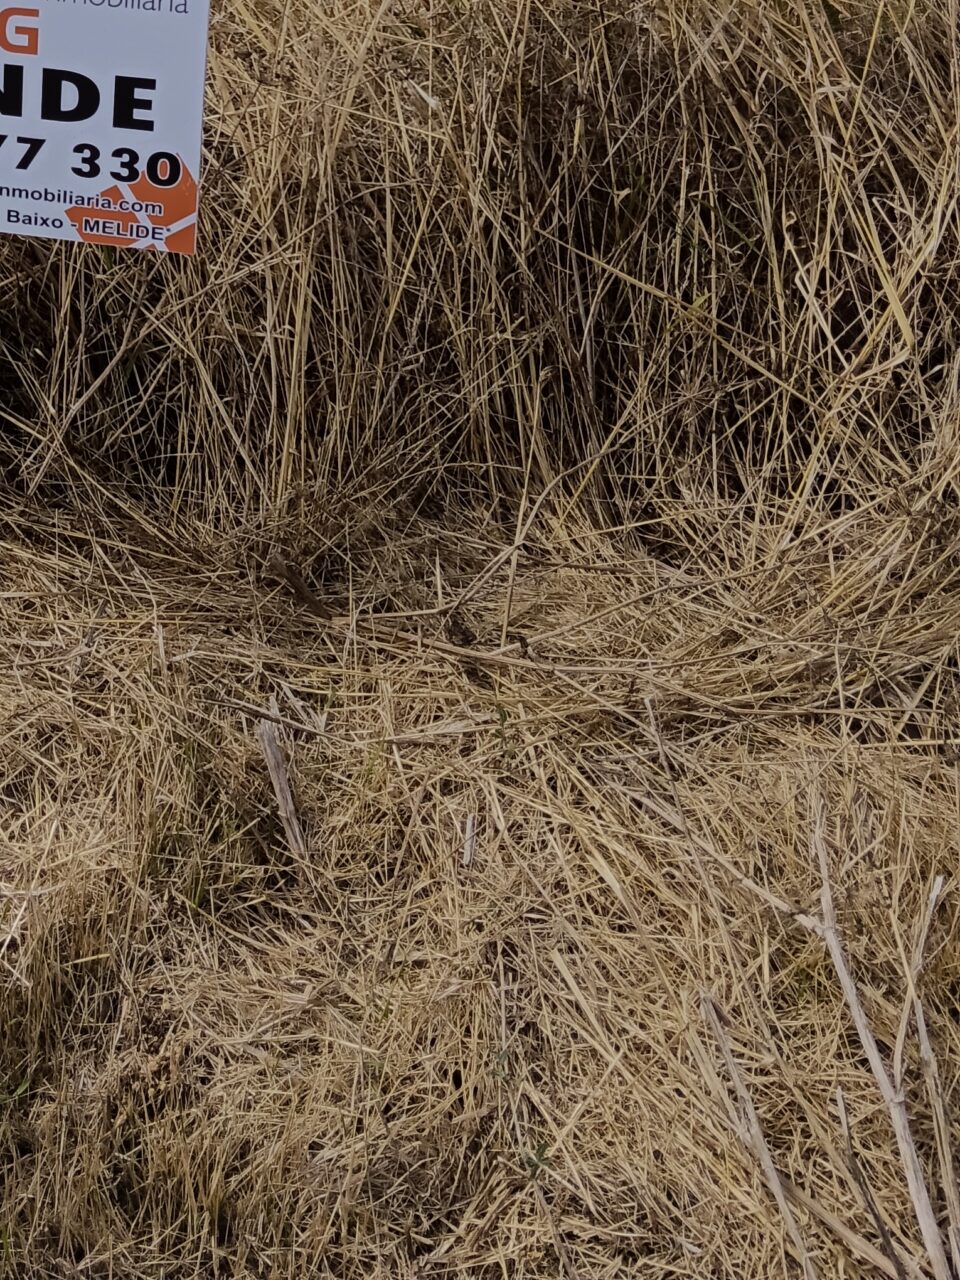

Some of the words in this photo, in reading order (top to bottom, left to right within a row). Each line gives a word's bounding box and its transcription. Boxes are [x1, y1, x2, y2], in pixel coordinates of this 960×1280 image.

[71, 143, 182, 187] 330
[7, 209, 64, 230] Baixo
[83, 217, 165, 241] MELIDE
